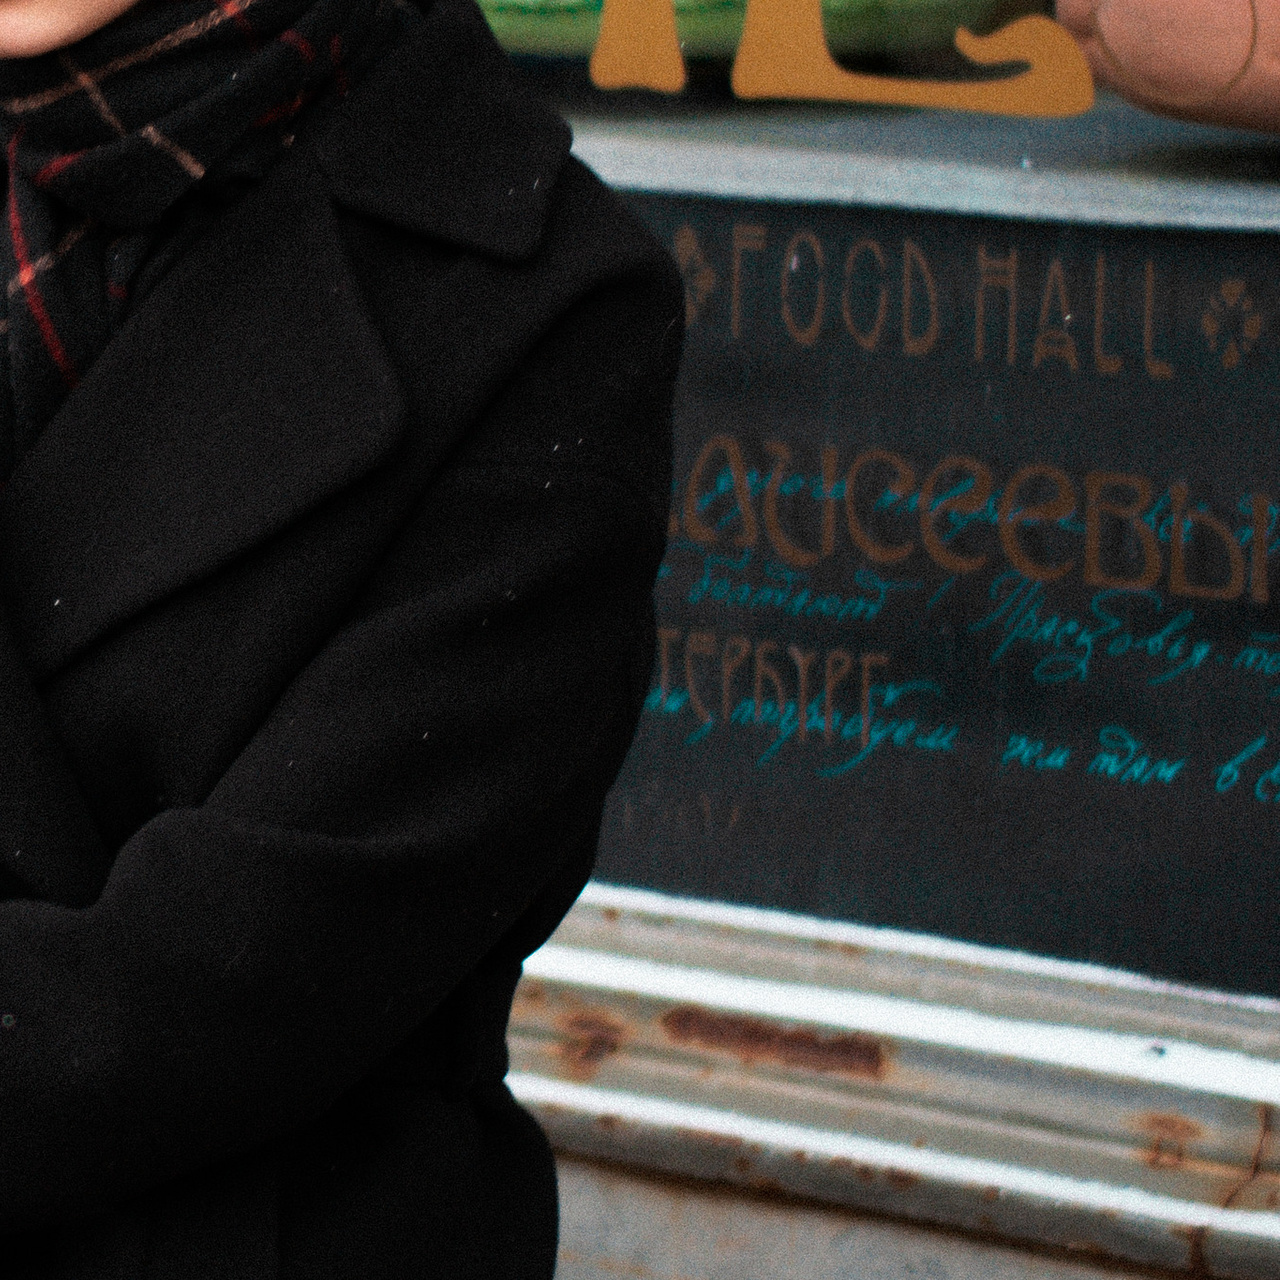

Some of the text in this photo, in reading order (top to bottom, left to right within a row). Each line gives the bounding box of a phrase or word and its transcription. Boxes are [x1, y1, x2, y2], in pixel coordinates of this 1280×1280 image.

[733, 222, 1173, 379] FOOD HALL
[655, 625, 891, 746] ТЕРБУРГ
